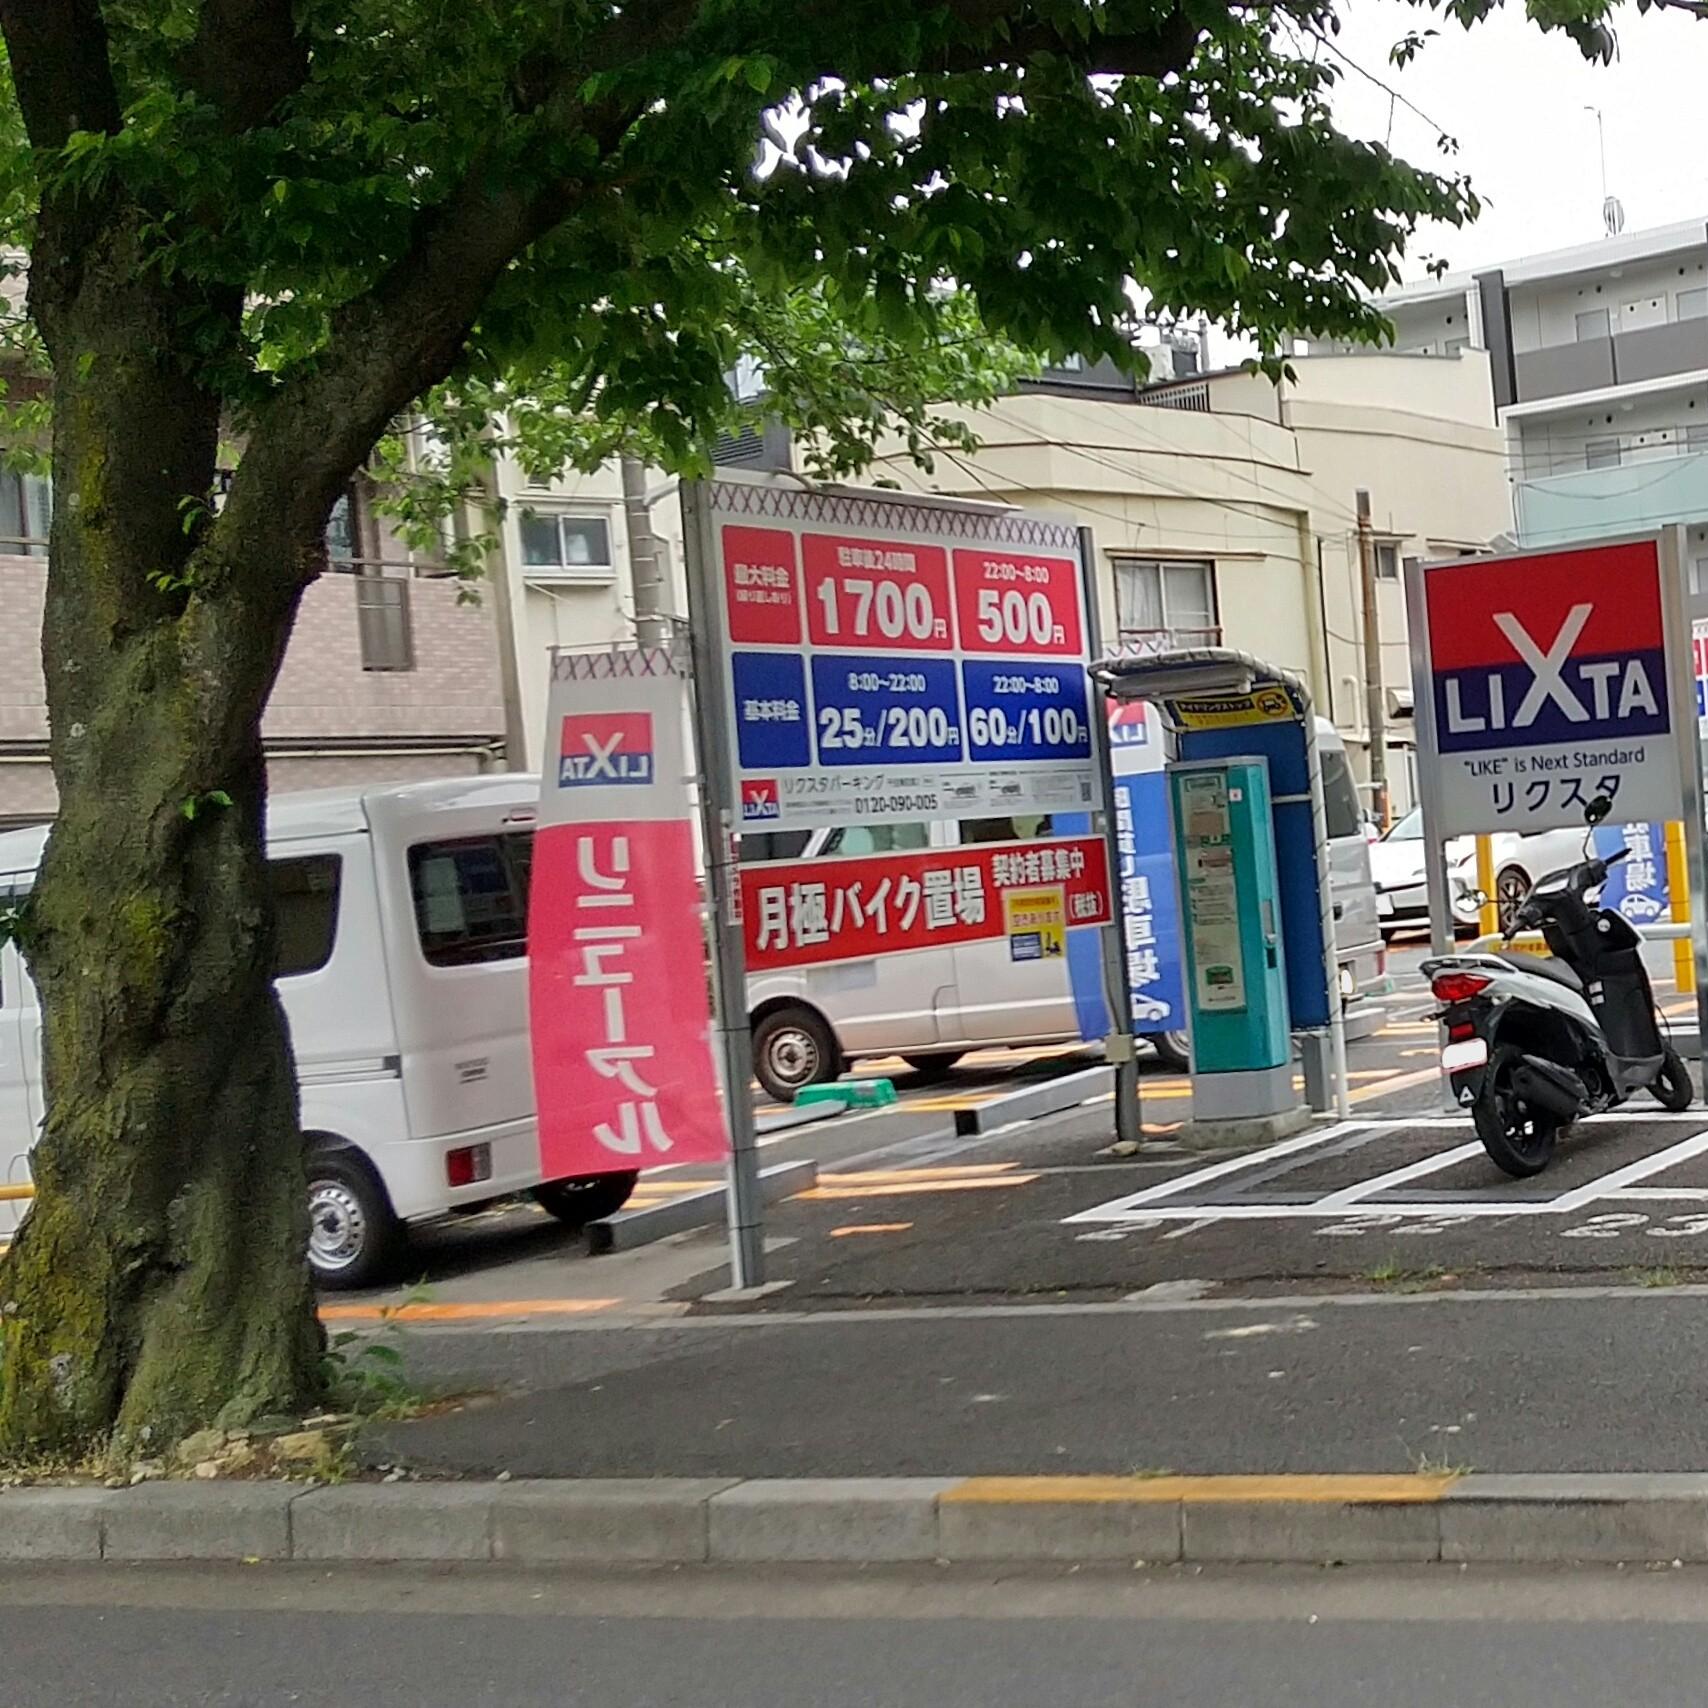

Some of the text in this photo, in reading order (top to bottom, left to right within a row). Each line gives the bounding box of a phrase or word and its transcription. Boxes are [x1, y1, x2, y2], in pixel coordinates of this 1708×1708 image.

[734, 563, 790, 588] 最大料金
[817, 576, 948, 640] 1700円
[977, 589, 1066, 645] 500円
[1444, 602, 1660, 736] LIXTA
[743, 699, 801, 721] 基本料金
[819, 707, 960, 749] 25分/200円
[968, 707, 1088, 746] 60分/100円
[1514, 757, 1528, 773] is
[1531, 753, 1570, 772] Next
[1573, 746, 1646, 768] Standard
[743, 789, 779, 817] LIXTA
[784, 774, 885, 794] リクスタパーキング
[1492, 774, 1621, 815] リクスタ
[991, 846, 1085, 887] 契約者募集中
[756, 866, 986, 952] 月極バイク置場
